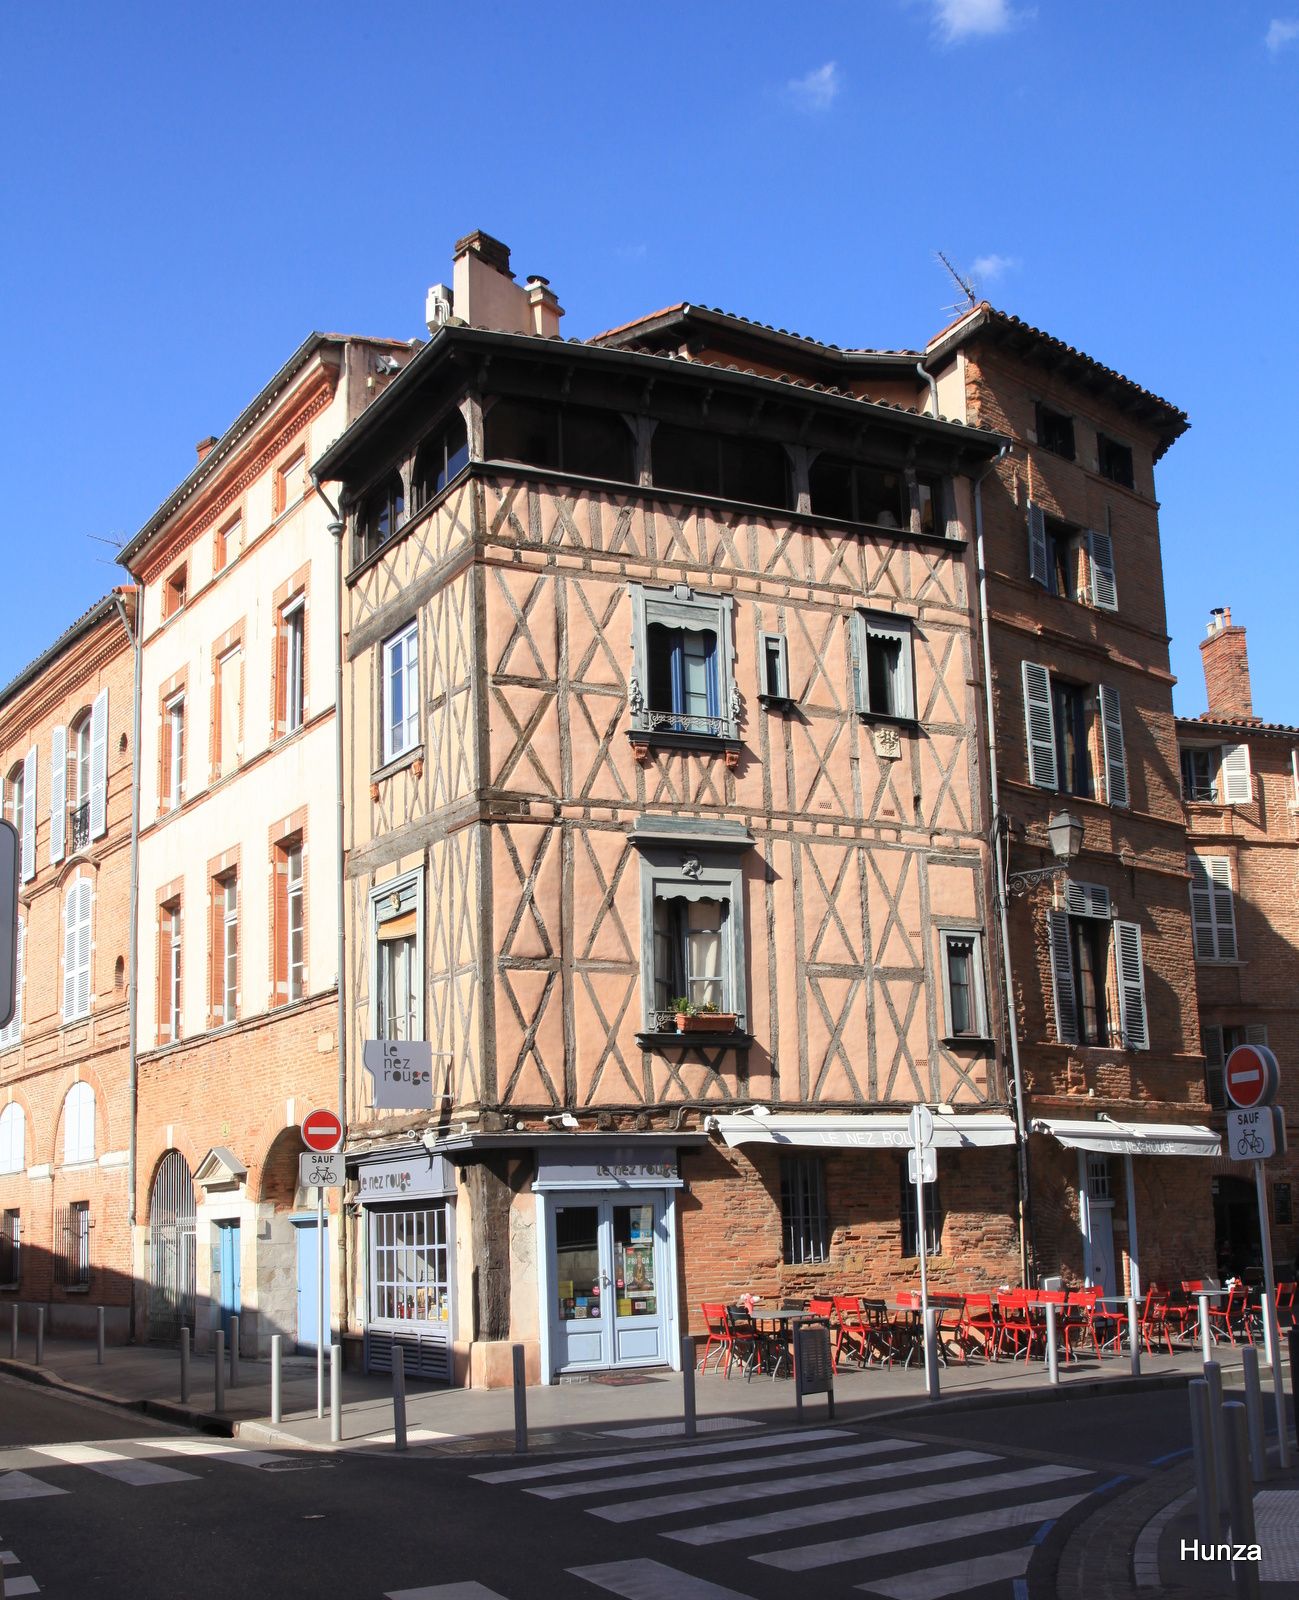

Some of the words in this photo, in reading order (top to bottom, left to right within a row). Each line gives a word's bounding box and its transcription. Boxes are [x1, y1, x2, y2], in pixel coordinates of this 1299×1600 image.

[383, 1042, 398, 1057] le
[383, 1058, 410, 1069] nez
[383, 1070, 430, 1086] rouge
[1237, 1112, 1259, 1125] SAUF
[820, 1132, 841, 1144] LE
[845, 1133, 876, 1145] NEZ
[1110, 1140, 1122, 1151] LE
[1145, 1141, 1176, 1153] ROUGE
[311, 1155, 335, 1164] SAUF
[596, 1164, 610, 1176] le
[614, 1163, 636, 1176] nez
[640, 1162, 678, 1178] rouge
[369, 1175, 384, 1191] nez
[385, 1172, 411, 1192] rouge
